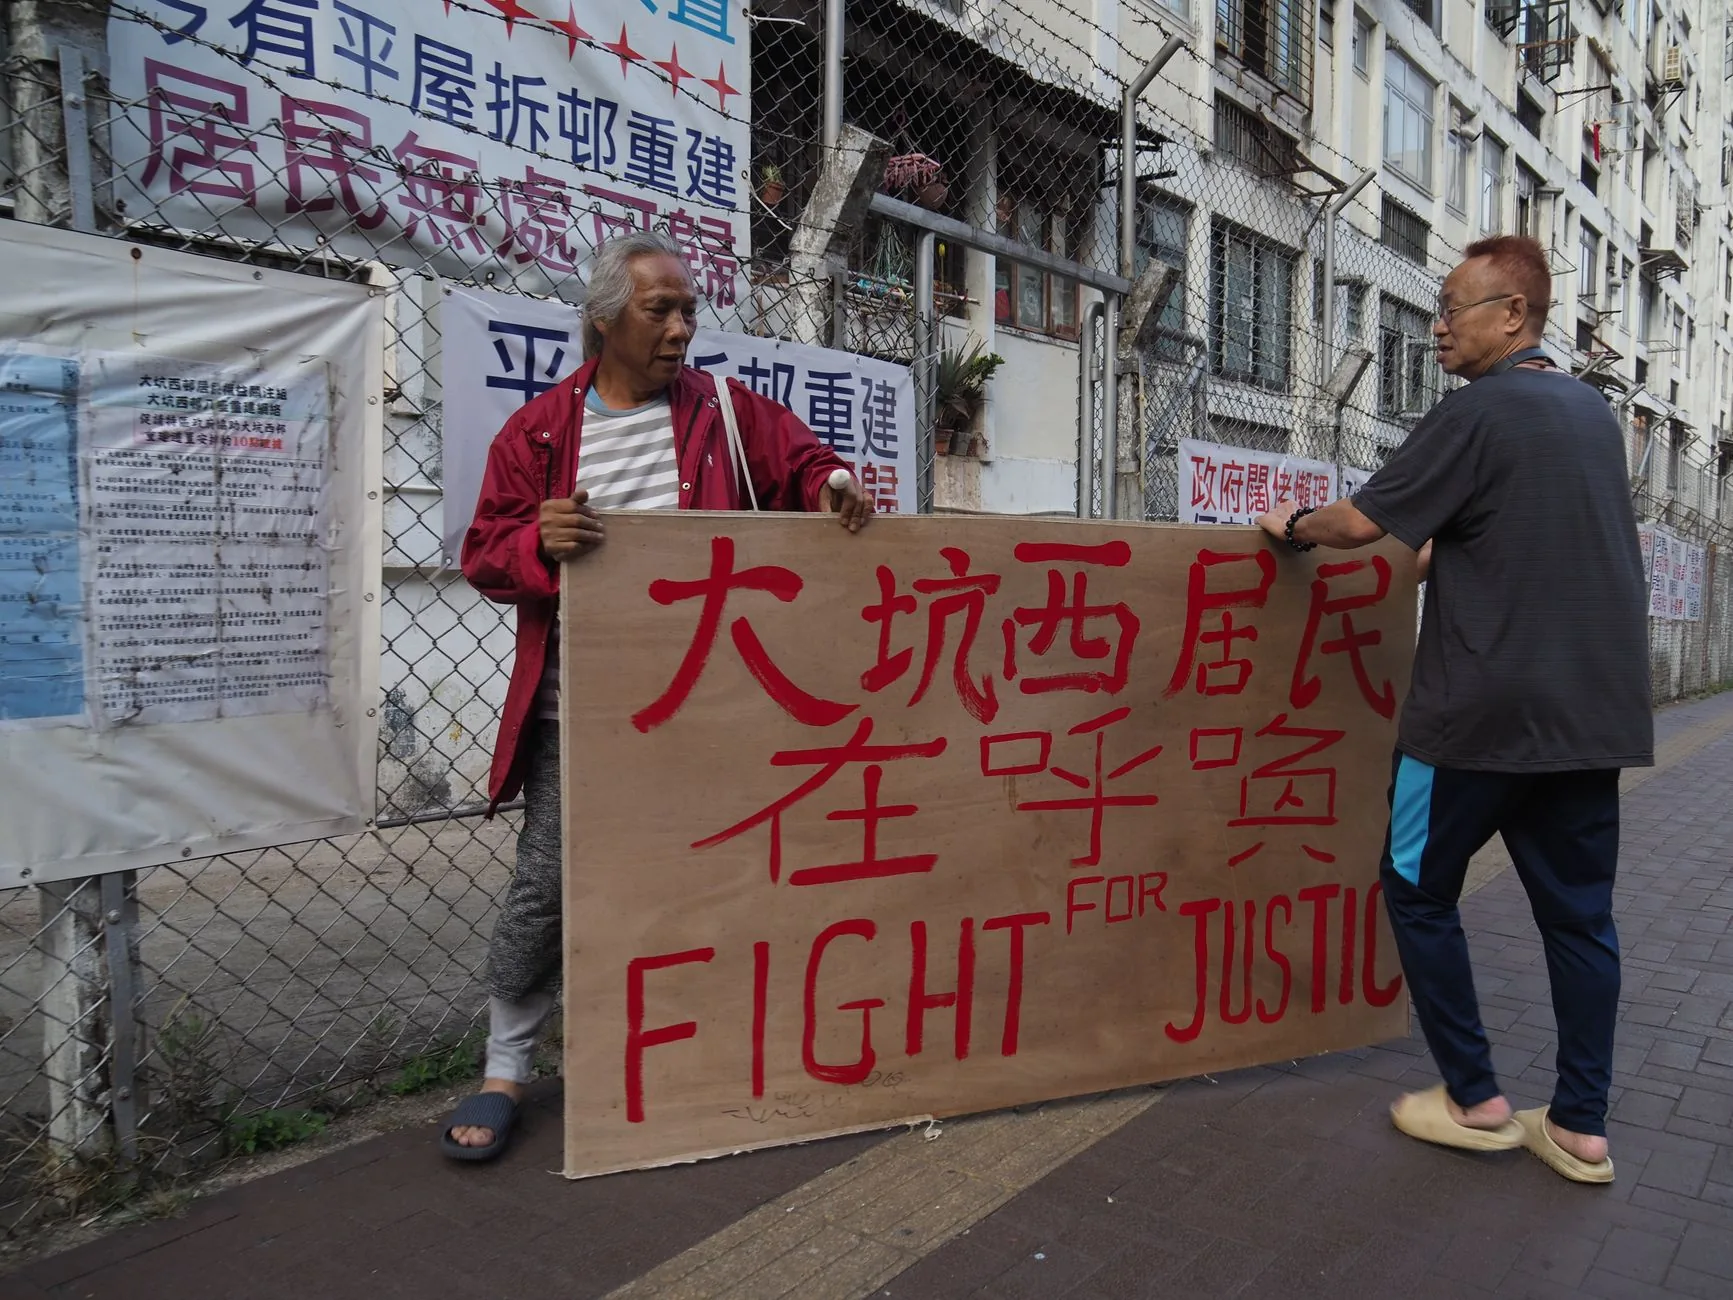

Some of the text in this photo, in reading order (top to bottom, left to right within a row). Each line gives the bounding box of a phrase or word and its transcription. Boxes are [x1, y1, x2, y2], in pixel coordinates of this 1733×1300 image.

[486, 320, 898, 459] 平邨重建
[1191, 455, 1329, 514] 政府闊佬懶理
[631, 537, 1398, 734] 大坑西居民
[625, 911, 1053, 1124] FIGHT
[1066, 871, 1170, 936] FOR
